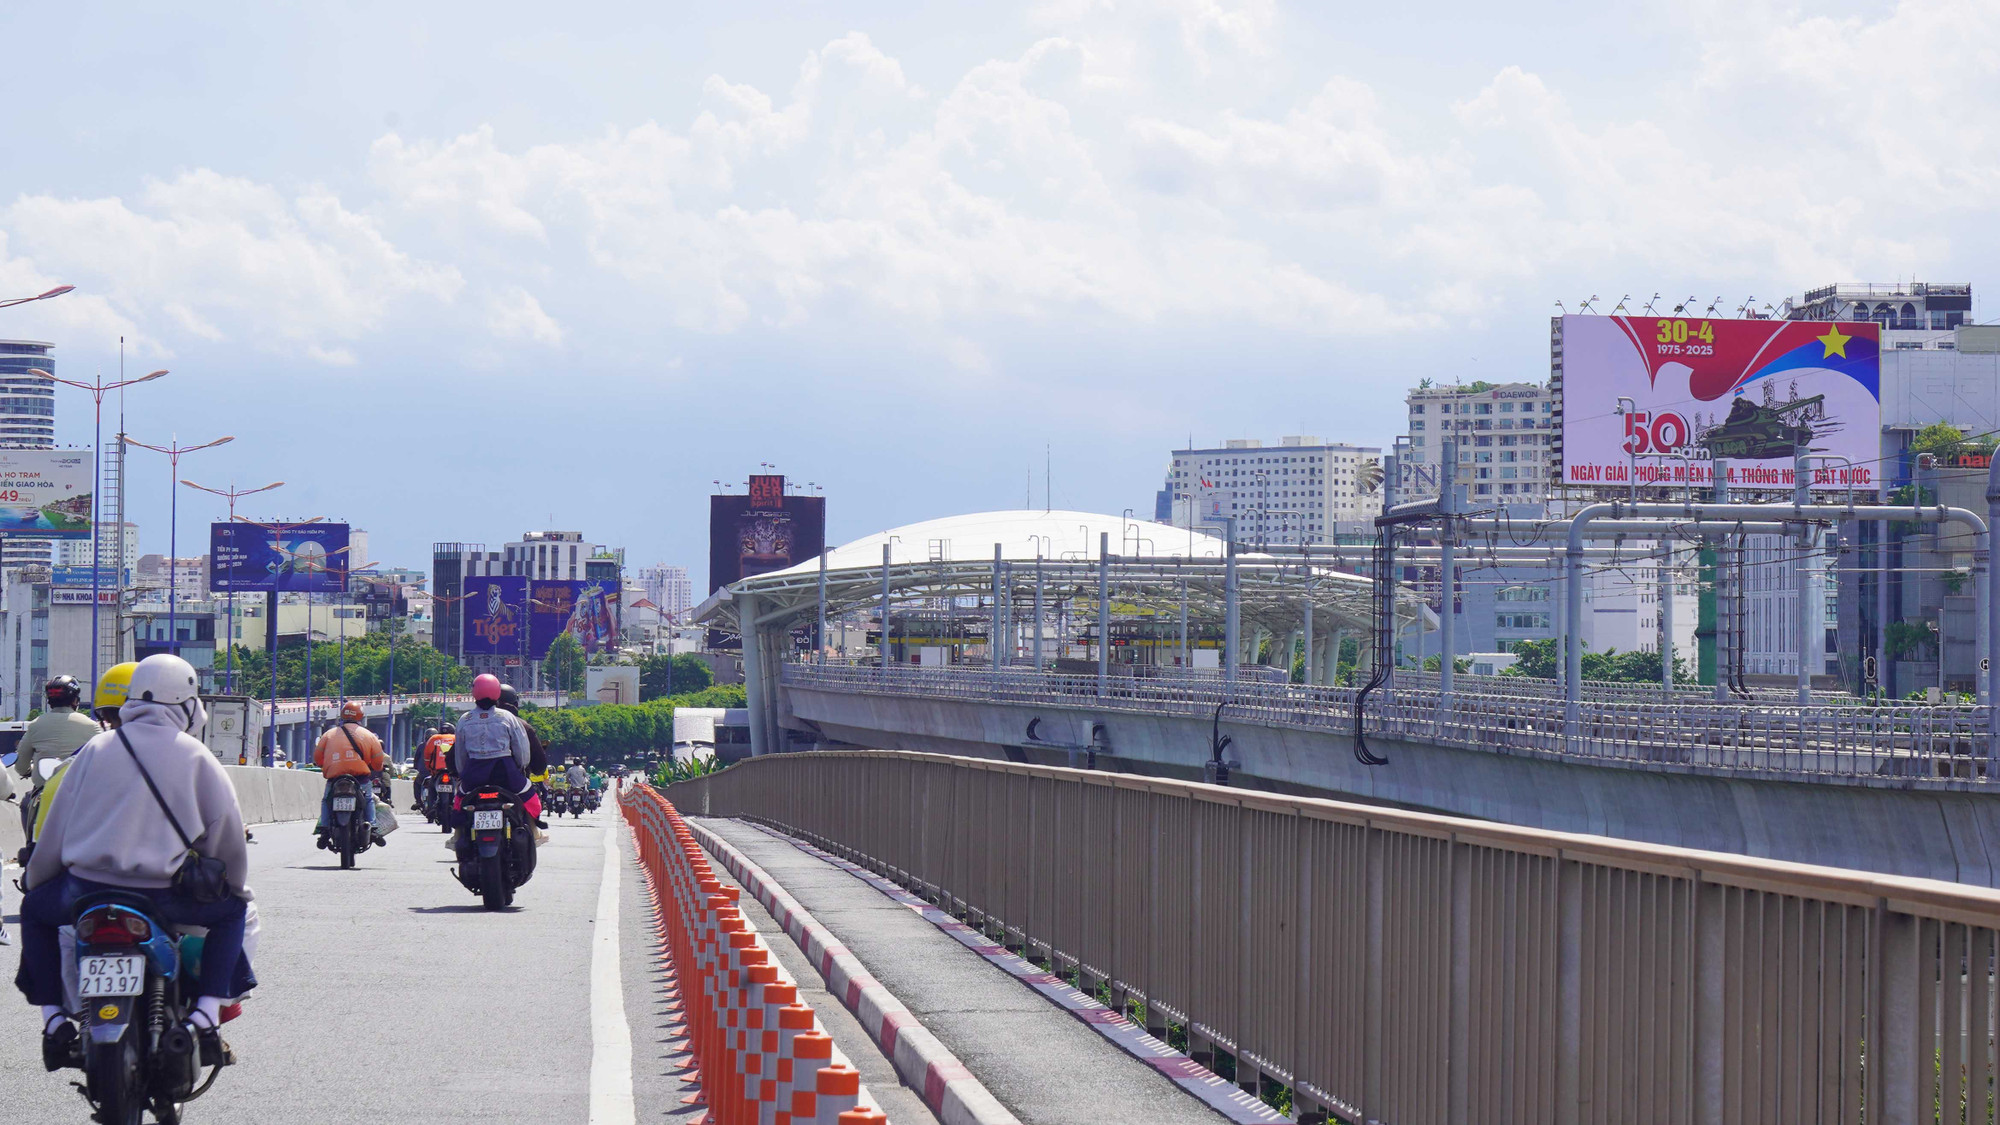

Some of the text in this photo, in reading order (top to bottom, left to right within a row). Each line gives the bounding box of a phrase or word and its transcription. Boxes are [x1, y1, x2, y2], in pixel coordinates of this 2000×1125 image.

[1656, 319, 1714, 344] 30-4
[1500, 391, 1538, 399] DAEWON
[1621, 411, 1688, 458] 50
[1571, 462, 1601, 481] NGÀY
[1605, 460, 1628, 481] GIẢI
[1674, 462, 1704, 483] MỀN
[1741, 462, 1778, 484] THỐNG
[752, 476, 781, 487] JUN
[751, 486, 783, 496] GER
[62, 592, 75, 601] NHA
[76, 592, 92, 601] KHOA
[473, 618, 517, 645] Tiger
[81, 976, 139, 994] 213.97
